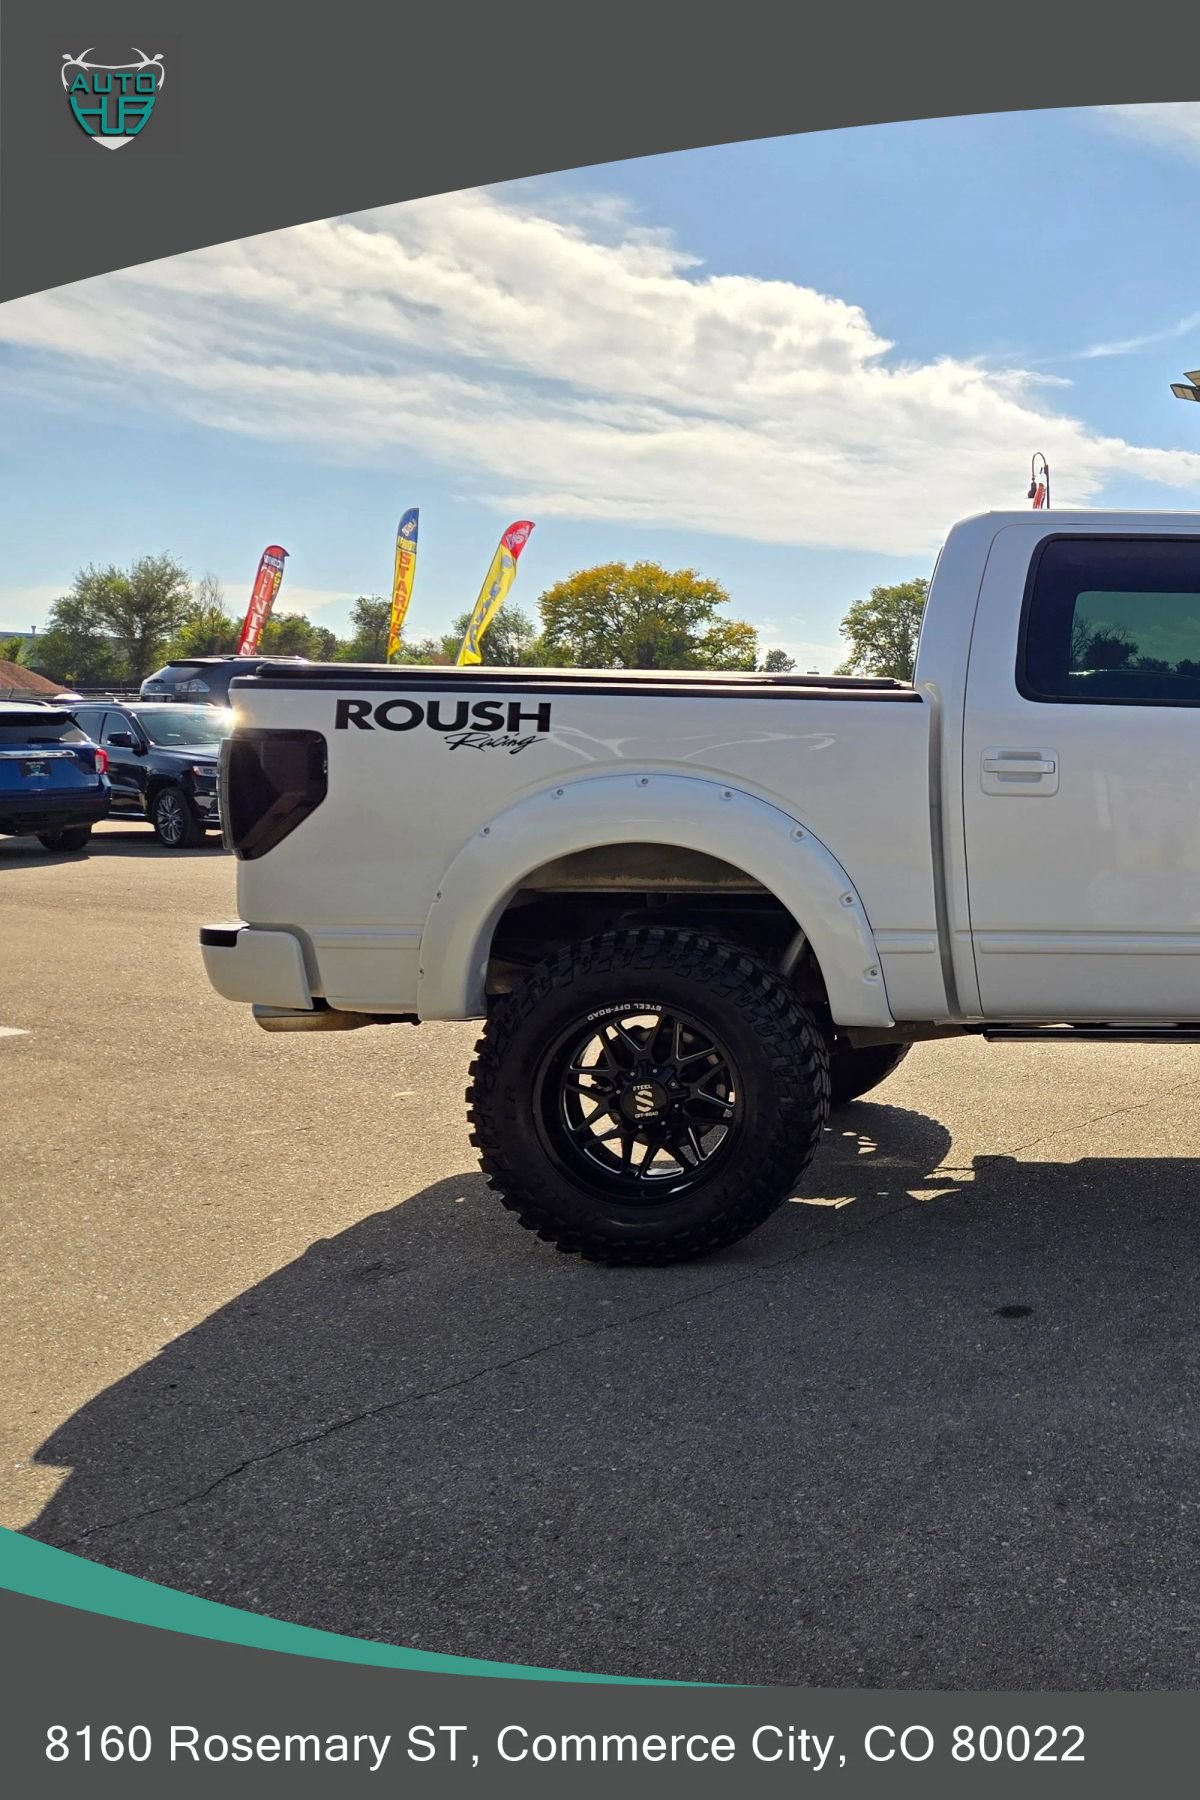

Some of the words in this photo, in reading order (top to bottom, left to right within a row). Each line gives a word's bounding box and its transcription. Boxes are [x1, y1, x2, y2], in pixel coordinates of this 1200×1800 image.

[335, 699, 552, 733] ROUSH
[444, 732, 548, 754] Racing
[587, 1003, 631, 1021] OFF-ROAD
[633, 1003, 662, 1011] STEEL
